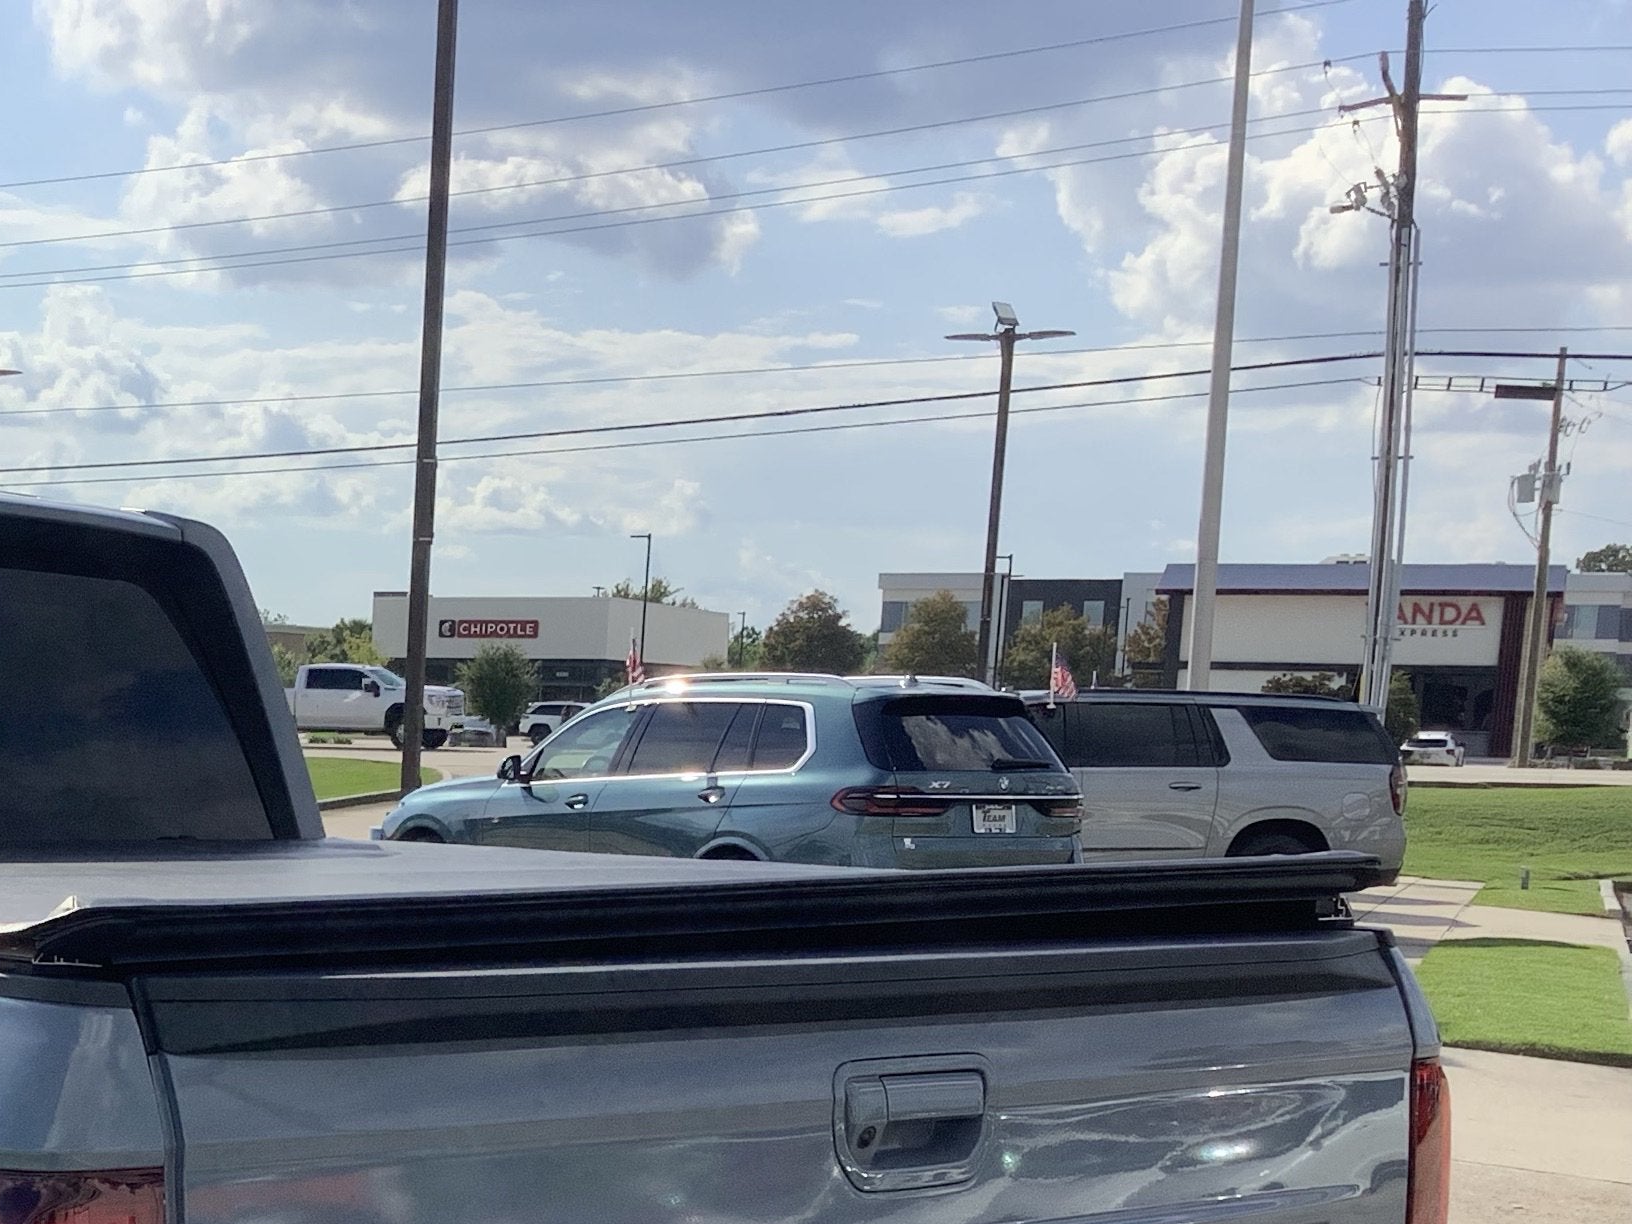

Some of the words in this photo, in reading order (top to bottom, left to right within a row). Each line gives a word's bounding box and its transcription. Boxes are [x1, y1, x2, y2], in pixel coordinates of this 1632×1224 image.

[1396, 601, 1486, 626] ANDA
[459, 621, 535, 636] CHIPOTLE
[1399, 628, 1458, 637] XPRESS
[928, 780, 951, 789] X7
